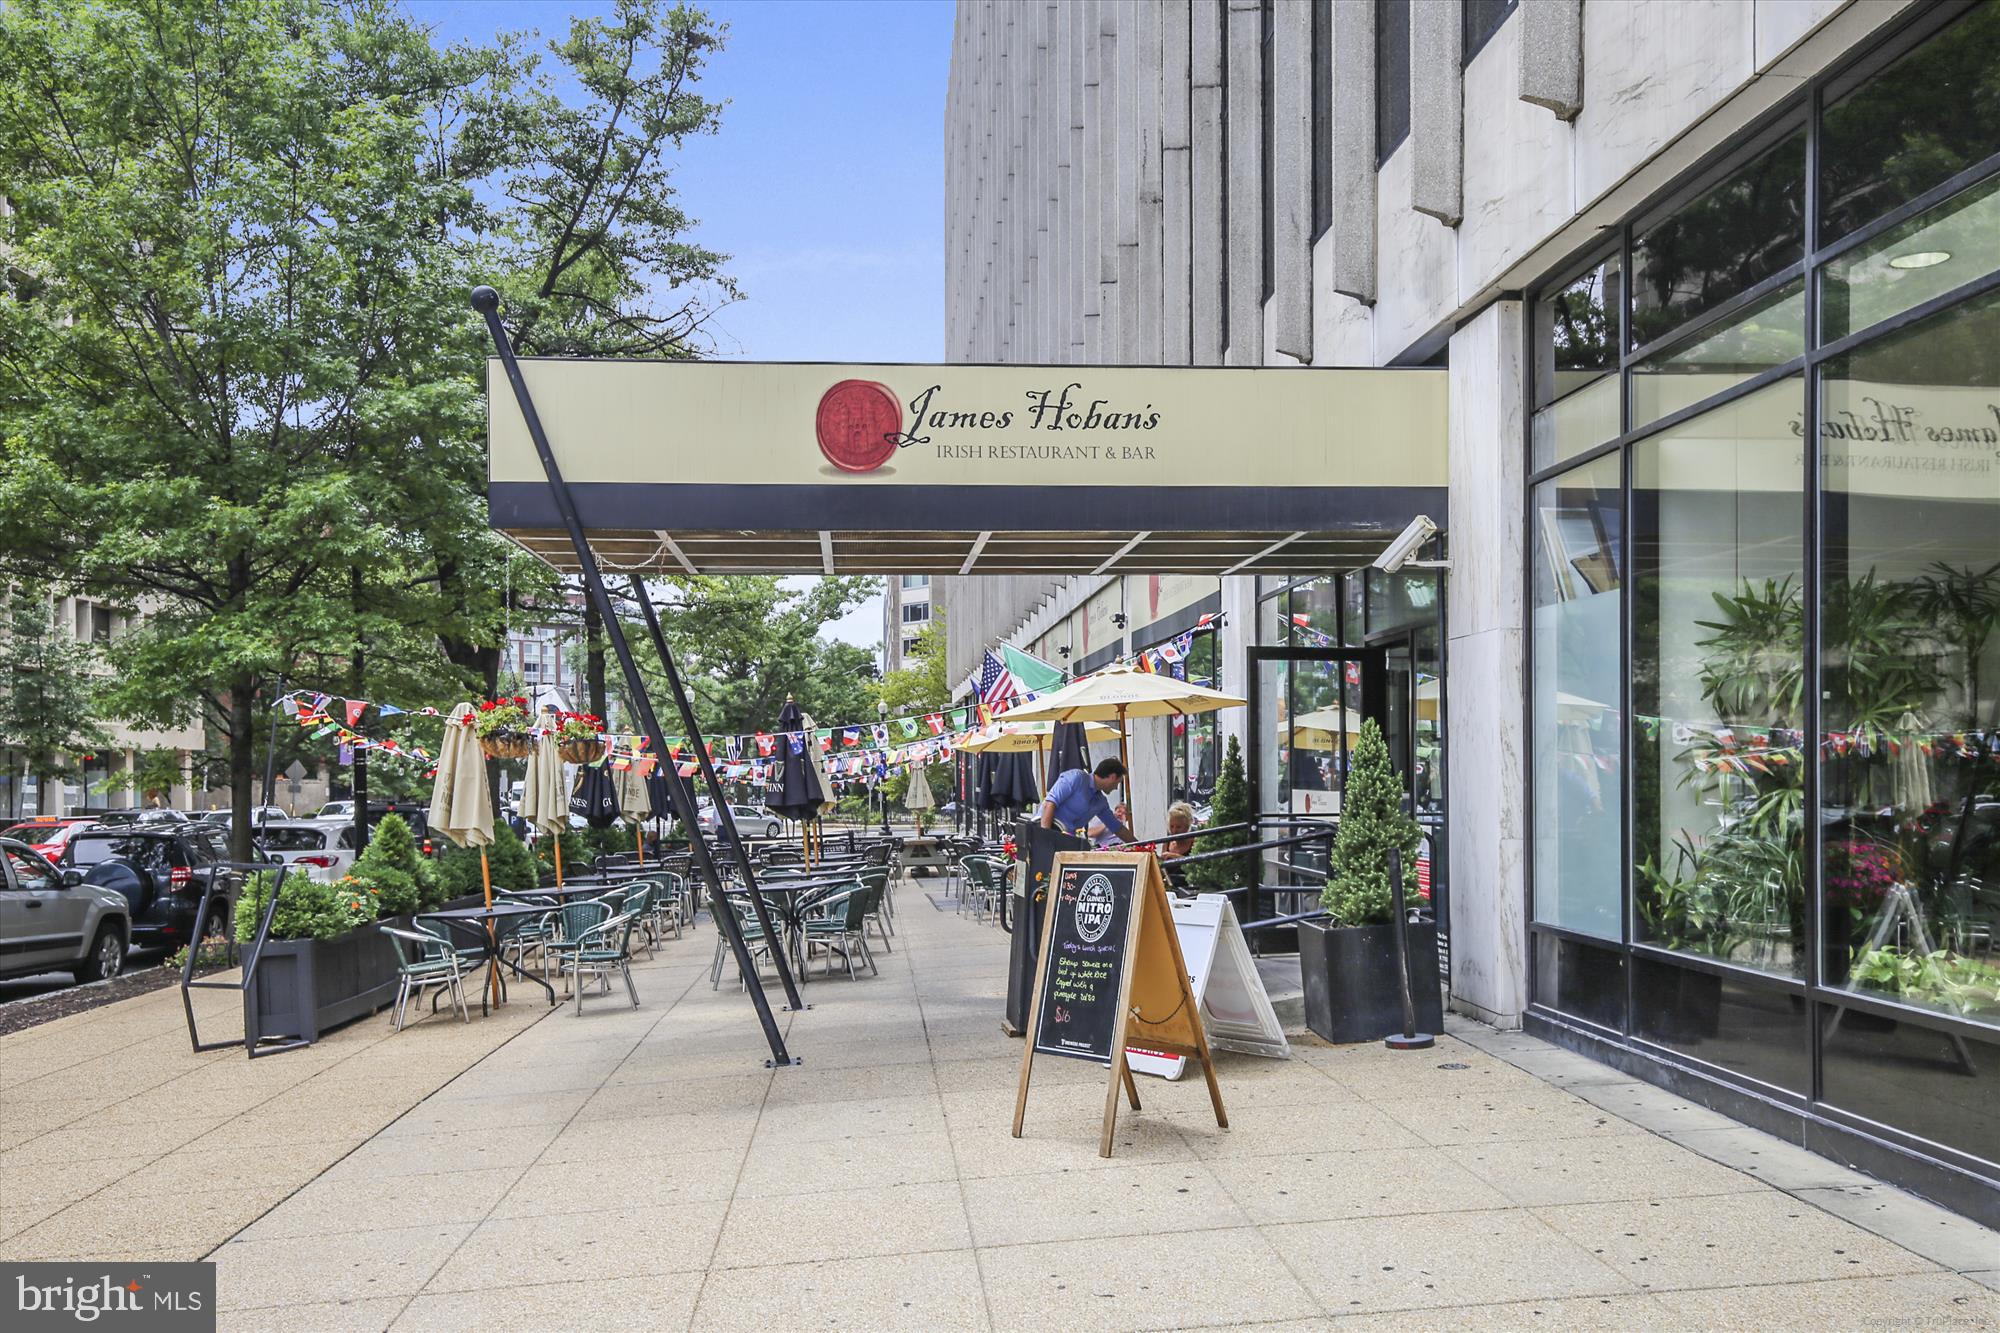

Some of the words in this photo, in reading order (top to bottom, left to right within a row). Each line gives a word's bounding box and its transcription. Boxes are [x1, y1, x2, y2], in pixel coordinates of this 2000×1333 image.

[884, 385, 1014, 448] James
[1026, 383, 1160, 430] Hoban's
[937, 445, 982, 458] IRISH
[989, 445, 1100, 459] RESTAURANT
[1105, 446, 1117, 459] &
[1122, 446, 1156, 459] BAR
[1078, 902, 1111, 914] NITRO
[1084, 914, 1101, 924] IPA
